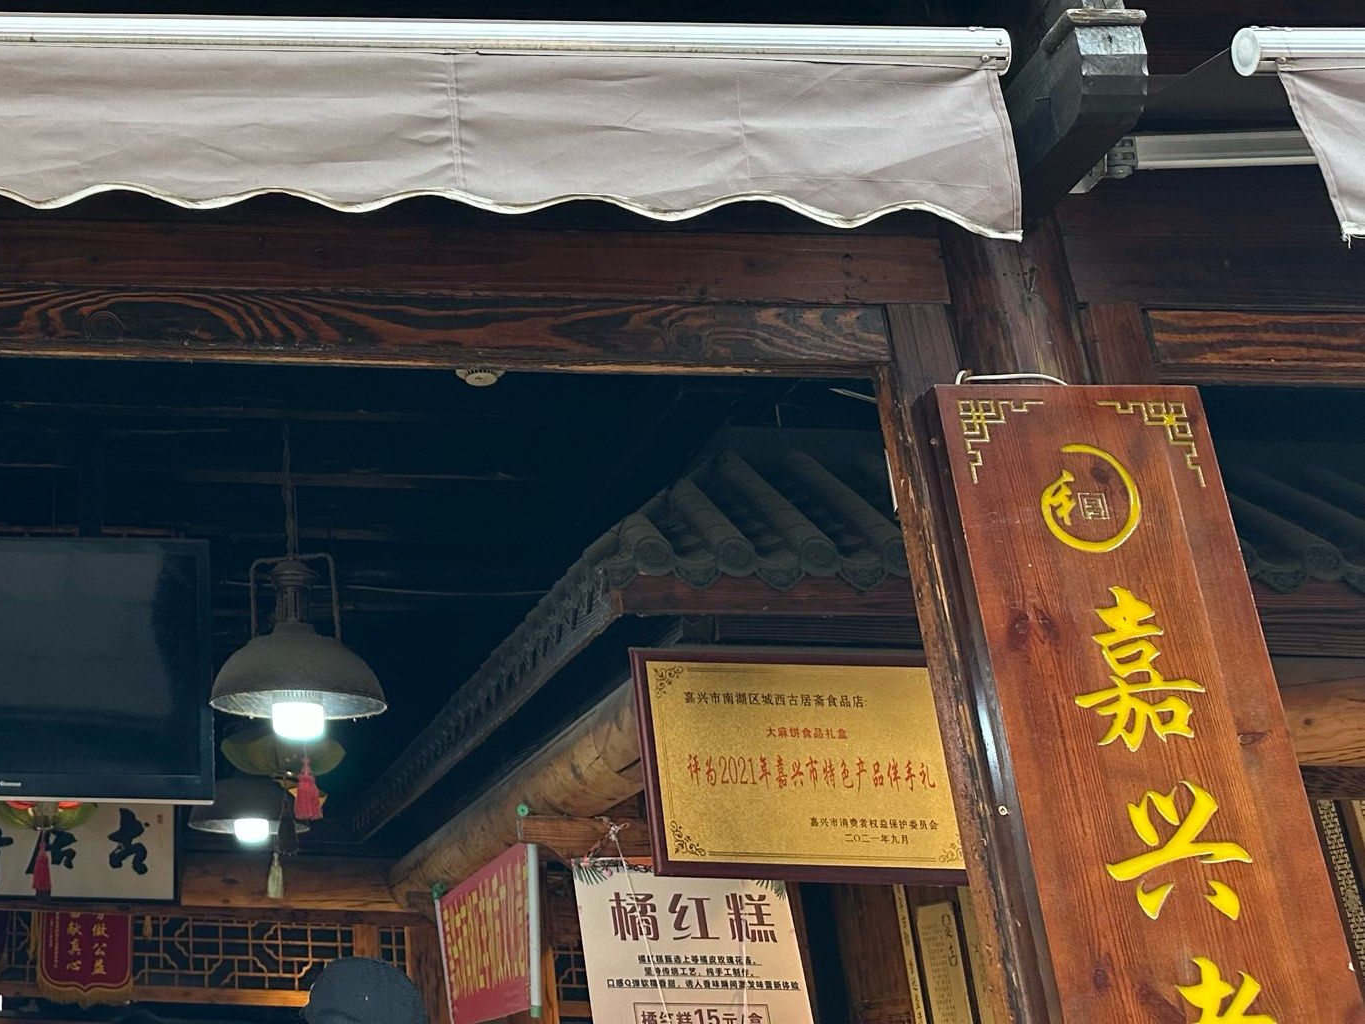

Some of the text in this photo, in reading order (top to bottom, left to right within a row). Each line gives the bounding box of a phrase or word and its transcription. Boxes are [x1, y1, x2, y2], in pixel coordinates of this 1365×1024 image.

[765, 726, 849, 740] 大麻饼食品礼盒
[686, 754, 937, 792] 评为2021年嘉兴市特色产品伴手礼
[809, 816, 939, 831] 嘉兴市消费者权益保护委员会
[608, 891, 779, 944] 橘红糕
